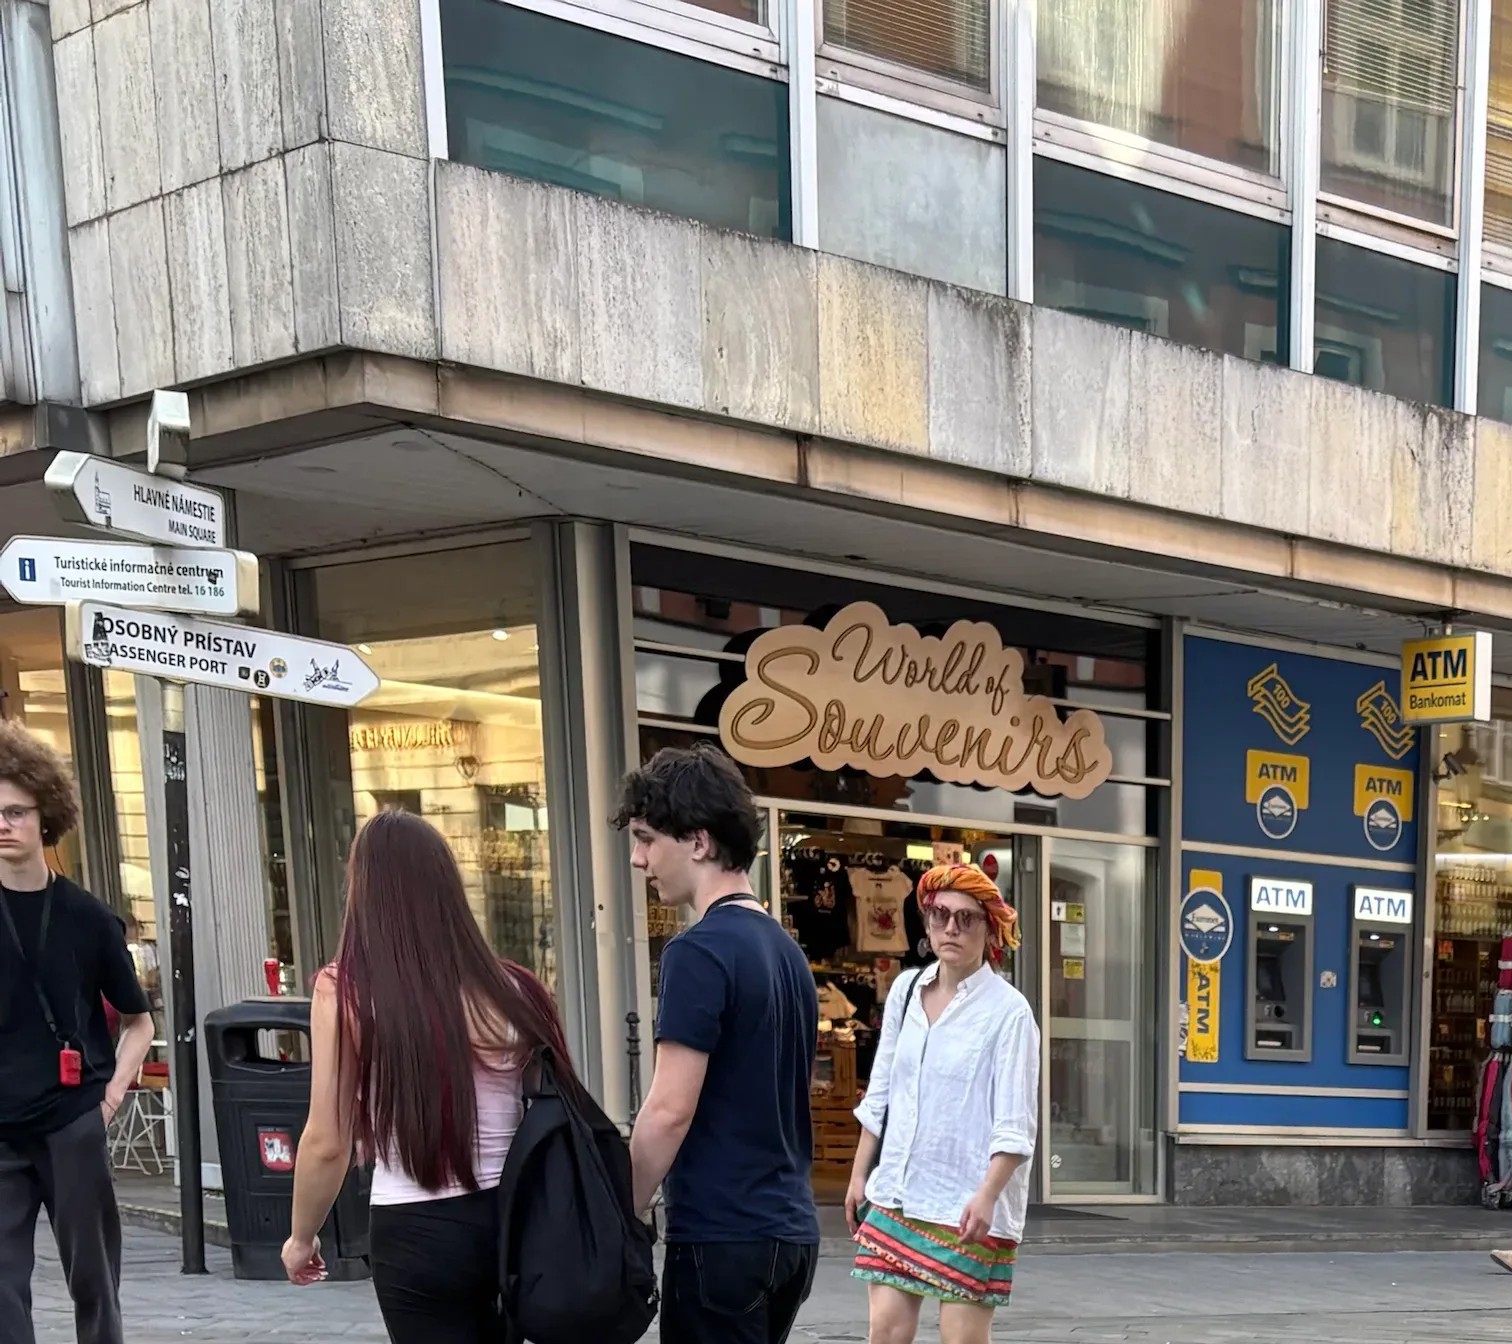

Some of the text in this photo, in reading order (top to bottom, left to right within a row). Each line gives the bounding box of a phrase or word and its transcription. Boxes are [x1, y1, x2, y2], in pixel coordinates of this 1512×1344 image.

[133, 484, 216, 523] HLAVNÉ NÁMESTIE
[168, 519, 216, 544] MAIN SQUARE
[54, 556, 108, 572] Turistické
[109, 558, 175, 577] informačné
[60, 577, 225, 598] Tourist Information Centre tel. 16 186
[184, 630, 257, 659] PRÍSTAV
[97, 643, 228, 677] ASSENGER PORT
[832, 622, 1010, 716] World of
[1410, 648, 1468, 682] ATM
[1273, 683, 1291, 709] 100
[1409, 692, 1466, 709] Bankomat
[730, 646, 1100, 785] Souvenirs
[1380, 699, 1397, 725] 100
[1258, 763, 1297, 783] ATM
[1365, 777, 1402, 796] ATM
[1256, 886, 1306, 908] ATM
[1359, 896, 1406, 918] ATM
[1197, 973, 1211, 1034] ATM
